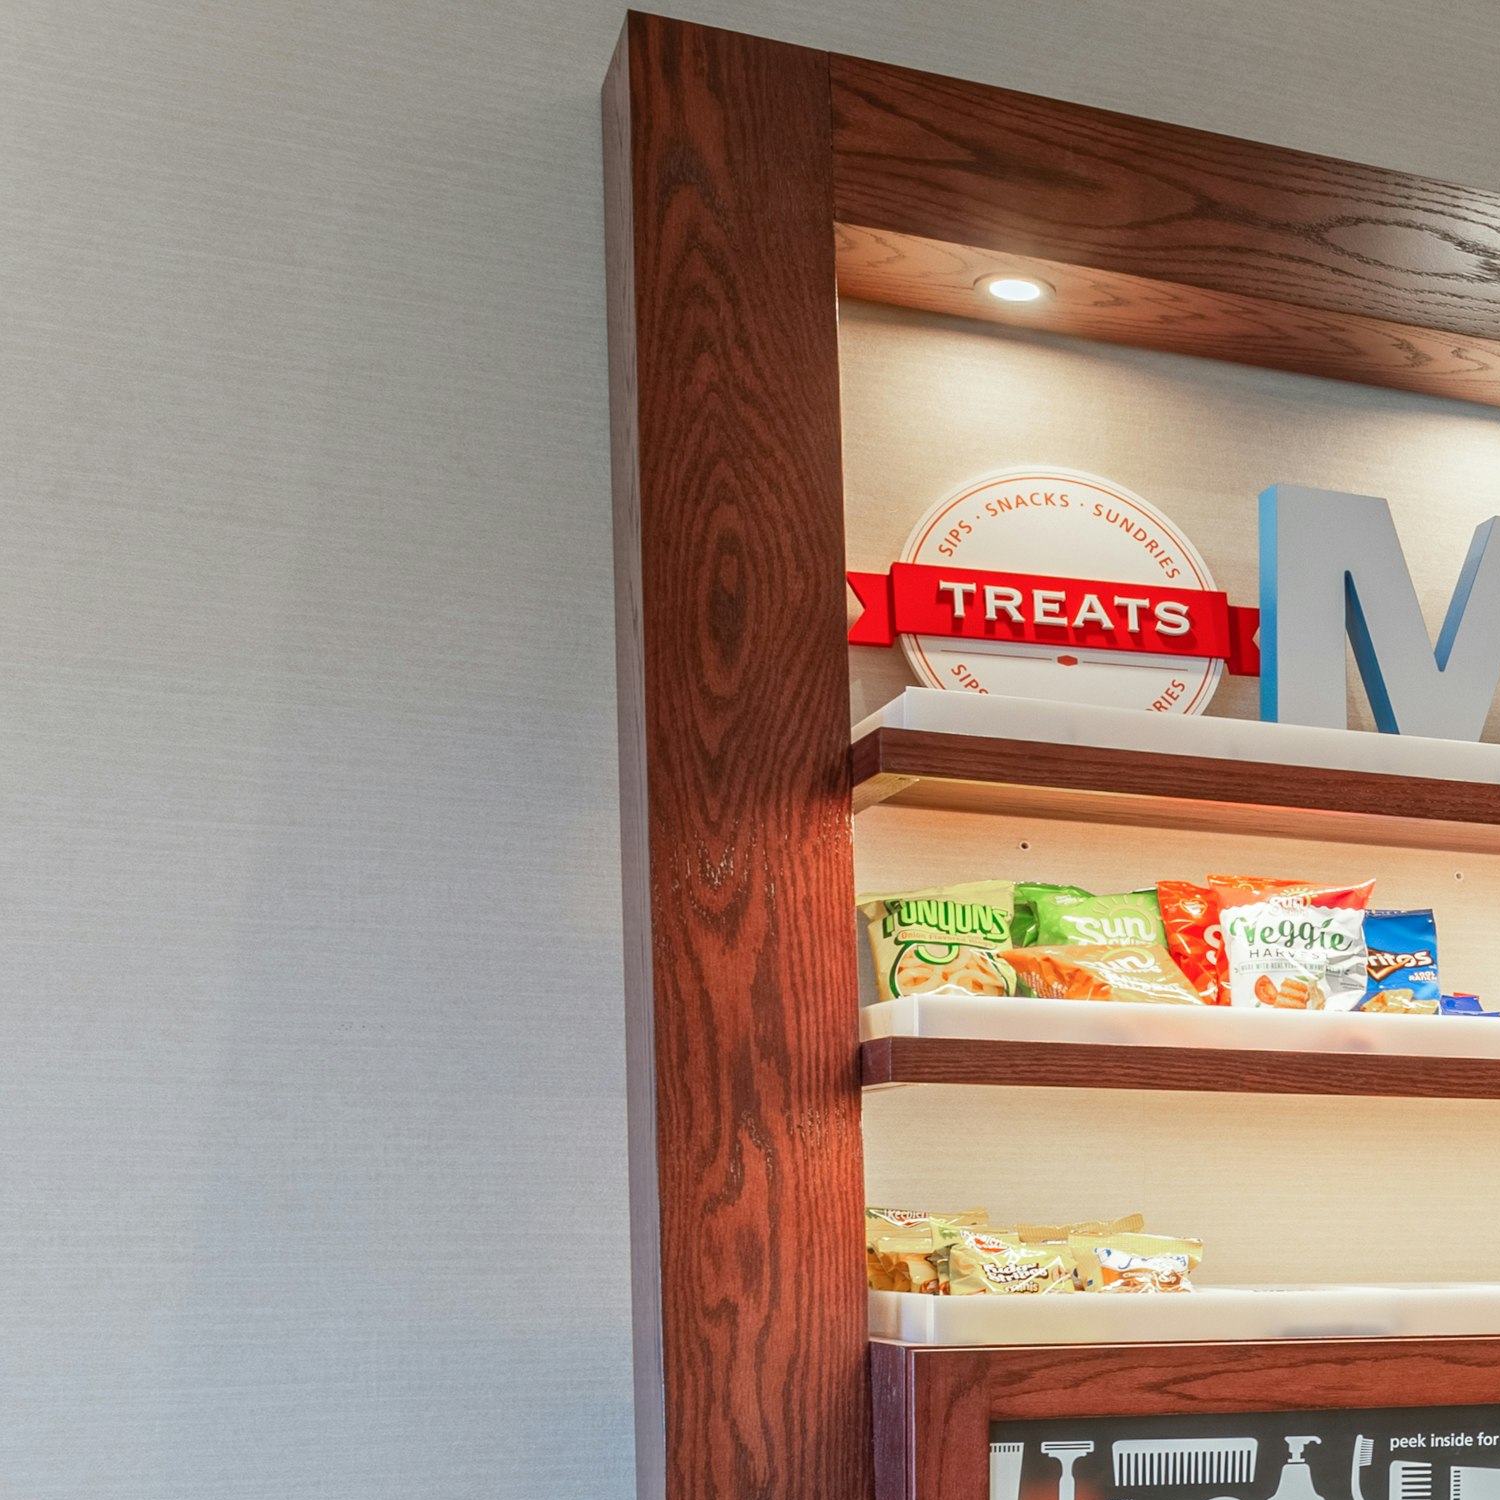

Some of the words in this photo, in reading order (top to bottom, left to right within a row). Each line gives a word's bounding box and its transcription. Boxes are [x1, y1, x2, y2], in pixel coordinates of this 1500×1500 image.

[938, 521, 974, 557] SIPS
[985, 492, 1070, 518] SNACKS
[1093, 503, 1181, 580] SUNDRIES
[938, 579, 1192, 637] TREATS
[1145, 679, 1186, 714] RIES
[1229, 917, 1353, 951] Veggie
[1368, 950, 1434, 968] ritos
[1389, 1431, 1426, 1451] peek
[1430, 1432, 1474, 1448] inside
[1476, 1431, 1500, 1447] for
